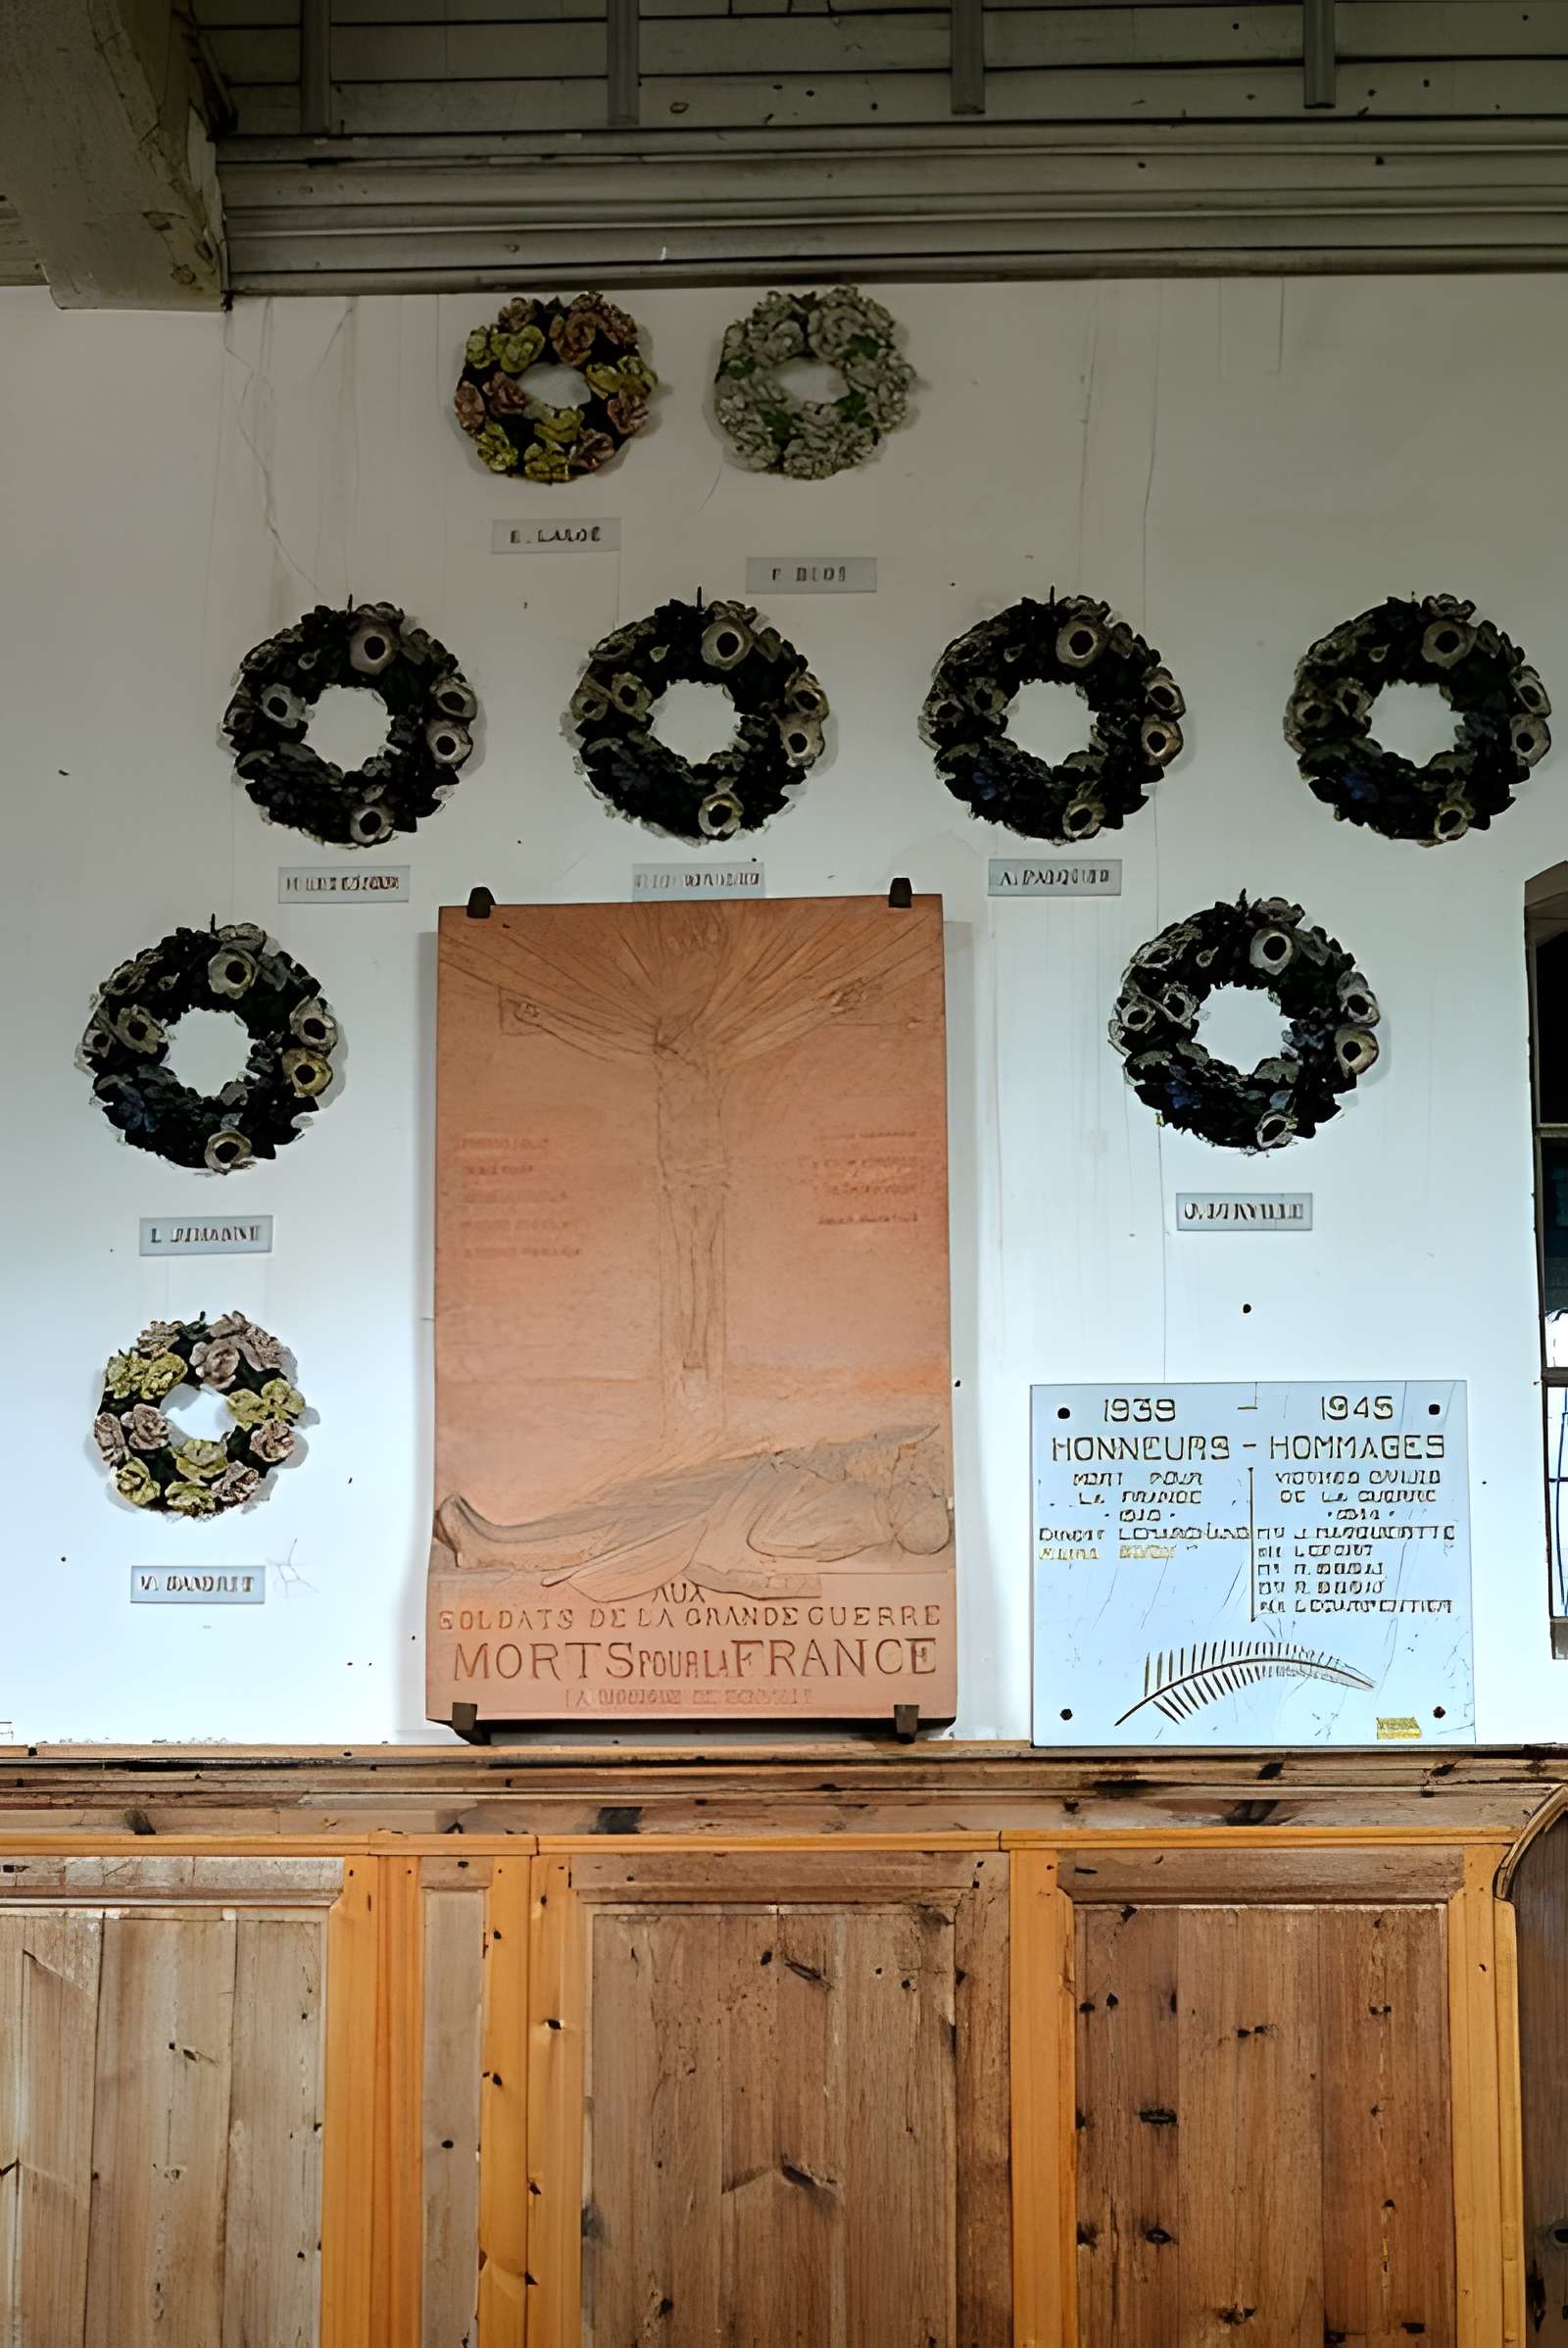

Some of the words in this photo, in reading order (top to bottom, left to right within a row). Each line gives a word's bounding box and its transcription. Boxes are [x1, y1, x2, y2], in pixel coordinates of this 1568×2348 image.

[1104, 1398, 1177, 1422] 1939
[1321, 1395, 1394, 1420] 1945
[1053, 1436, 1230, 1461] HONNEURS
[1270, 1435, 1445, 1459] HOMMAGES
[651, 1582, 706, 1604] AUX
[438, 1608, 574, 1632] SOLDATS
[589, 1607, 627, 1629] DE
[638, 1607, 675, 1628] LA
[685, 1605, 799, 1627] GRANDE
[808, 1604, 941, 1627] GUERRE
[453, 1640, 635, 1682] MORTS
[731, 1637, 938, 1679] FRANCE
